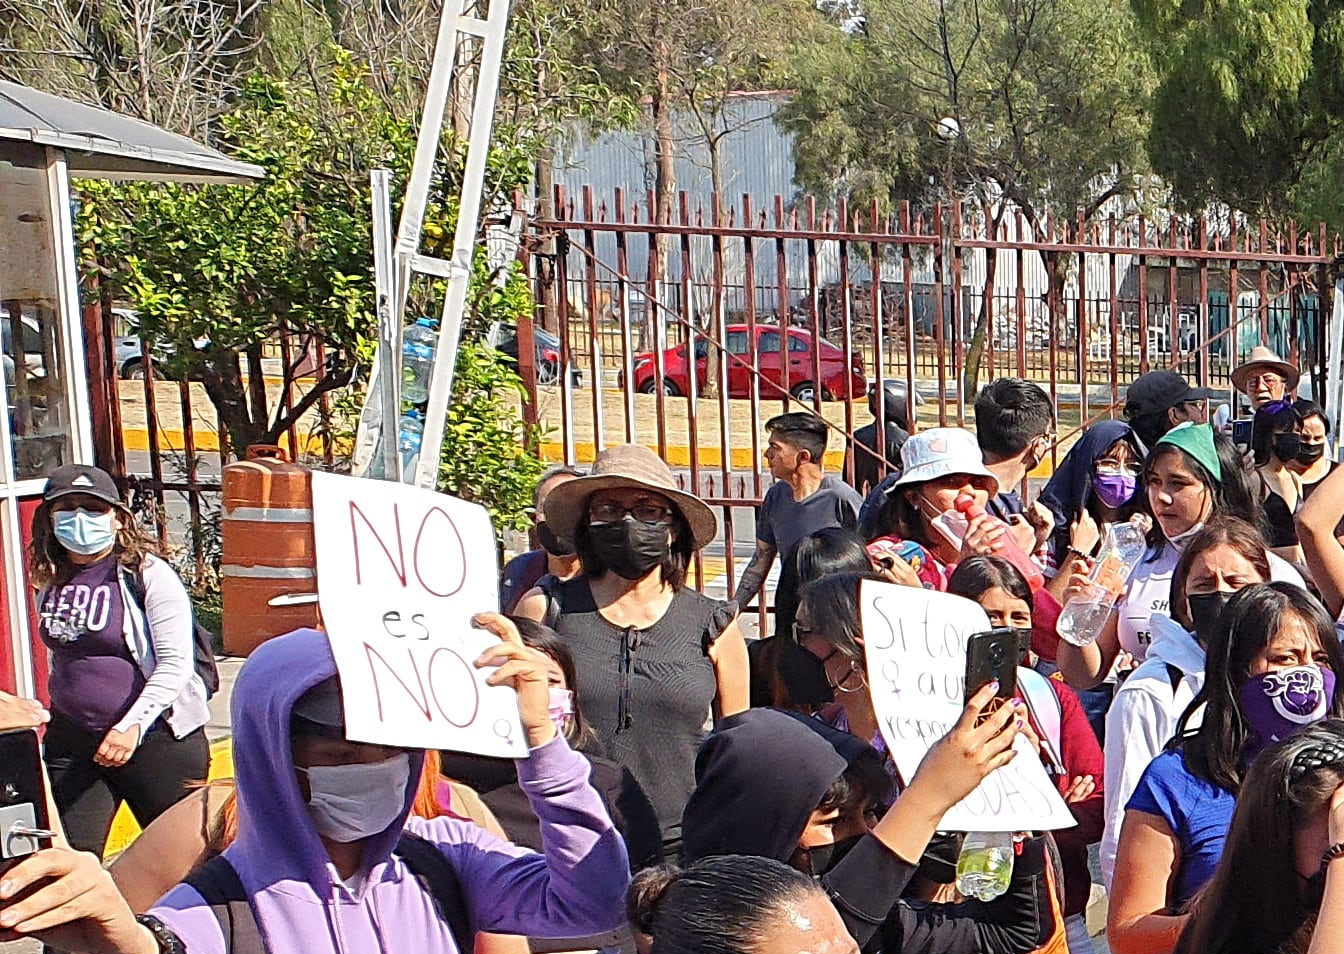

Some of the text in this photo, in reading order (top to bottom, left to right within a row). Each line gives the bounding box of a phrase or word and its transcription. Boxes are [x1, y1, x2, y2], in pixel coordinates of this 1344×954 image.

[349, 500, 467, 598] NO
[381, 610, 430, 641] es
[362, 640, 480, 729] NO
[917, 672, 937, 698] a
